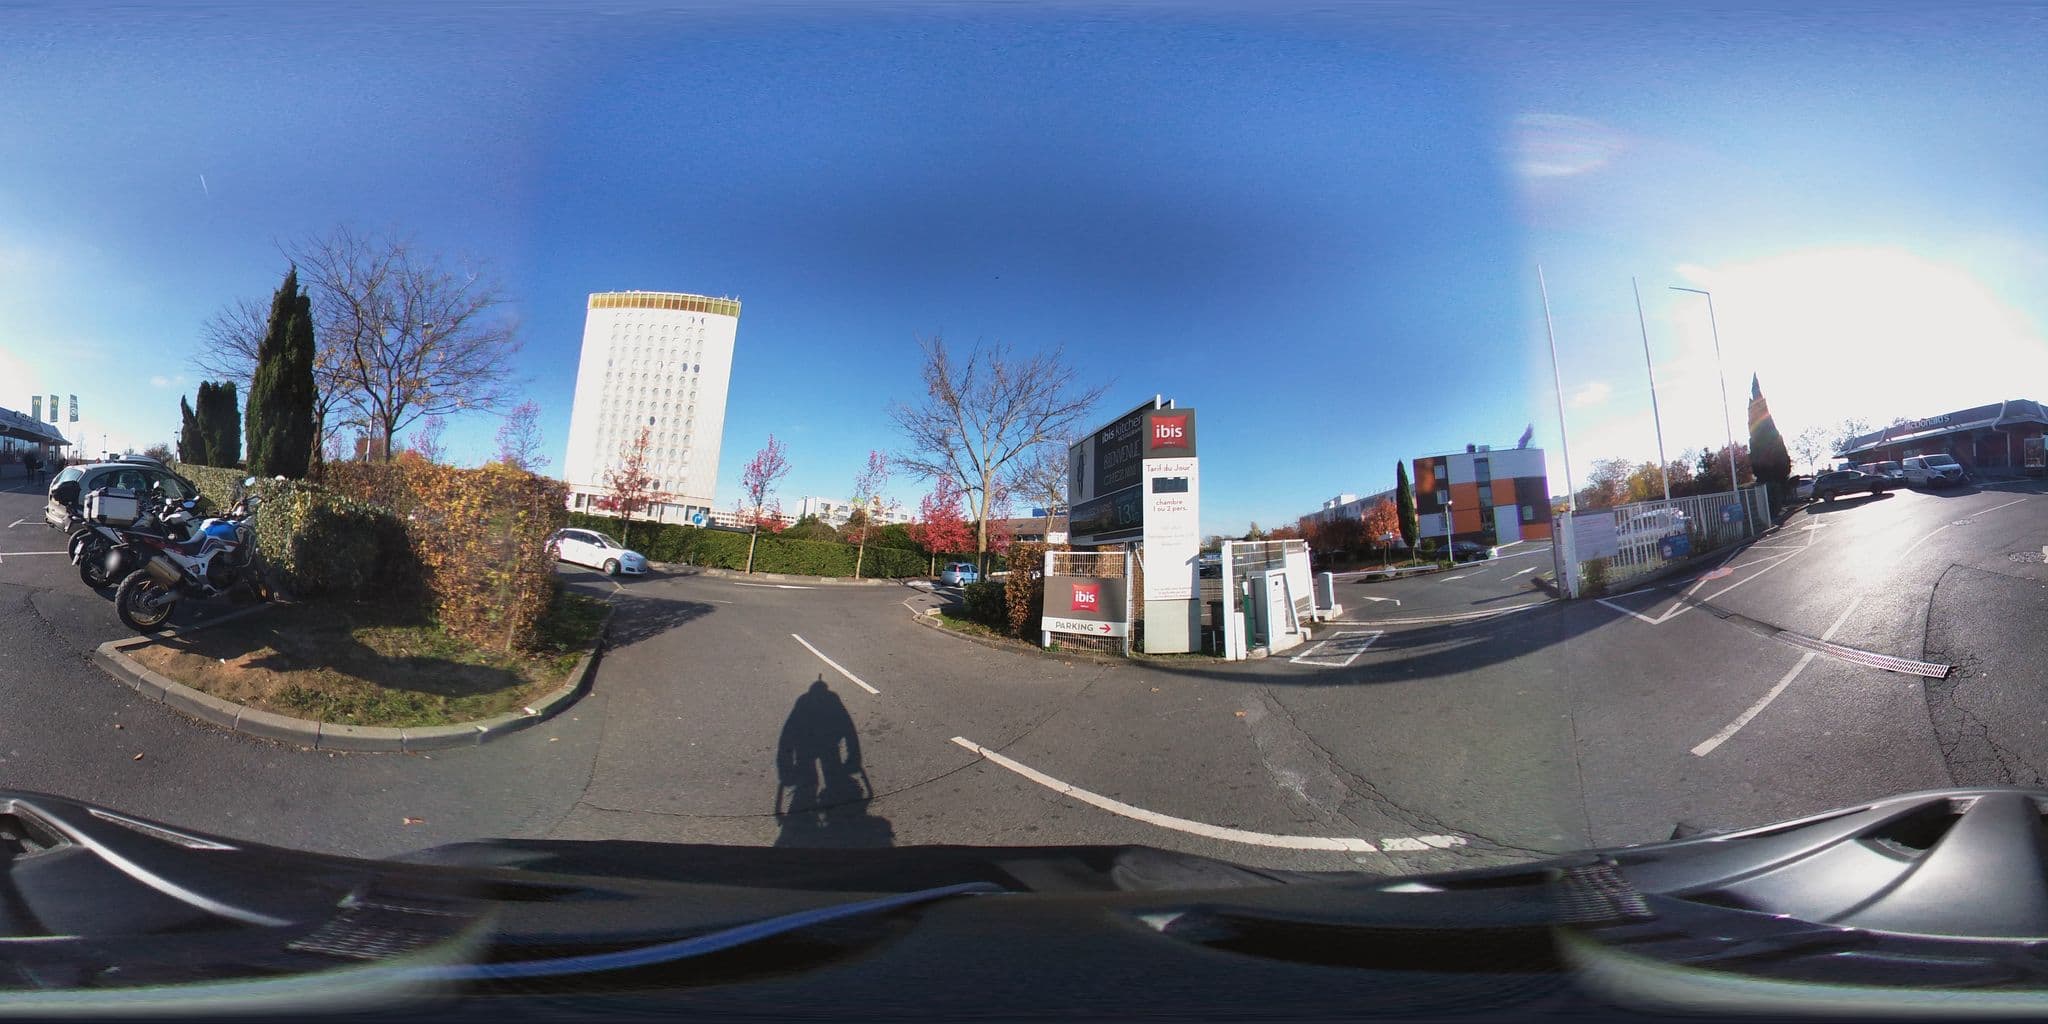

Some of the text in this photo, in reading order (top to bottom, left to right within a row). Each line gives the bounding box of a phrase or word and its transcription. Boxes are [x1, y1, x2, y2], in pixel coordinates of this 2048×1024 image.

[1156, 424, 1183, 438] ibis
[1146, 464, 1161, 472] Tarif
[1075, 591, 1095, 603] ibis
[1055, 622, 1094, 632] PARKING
